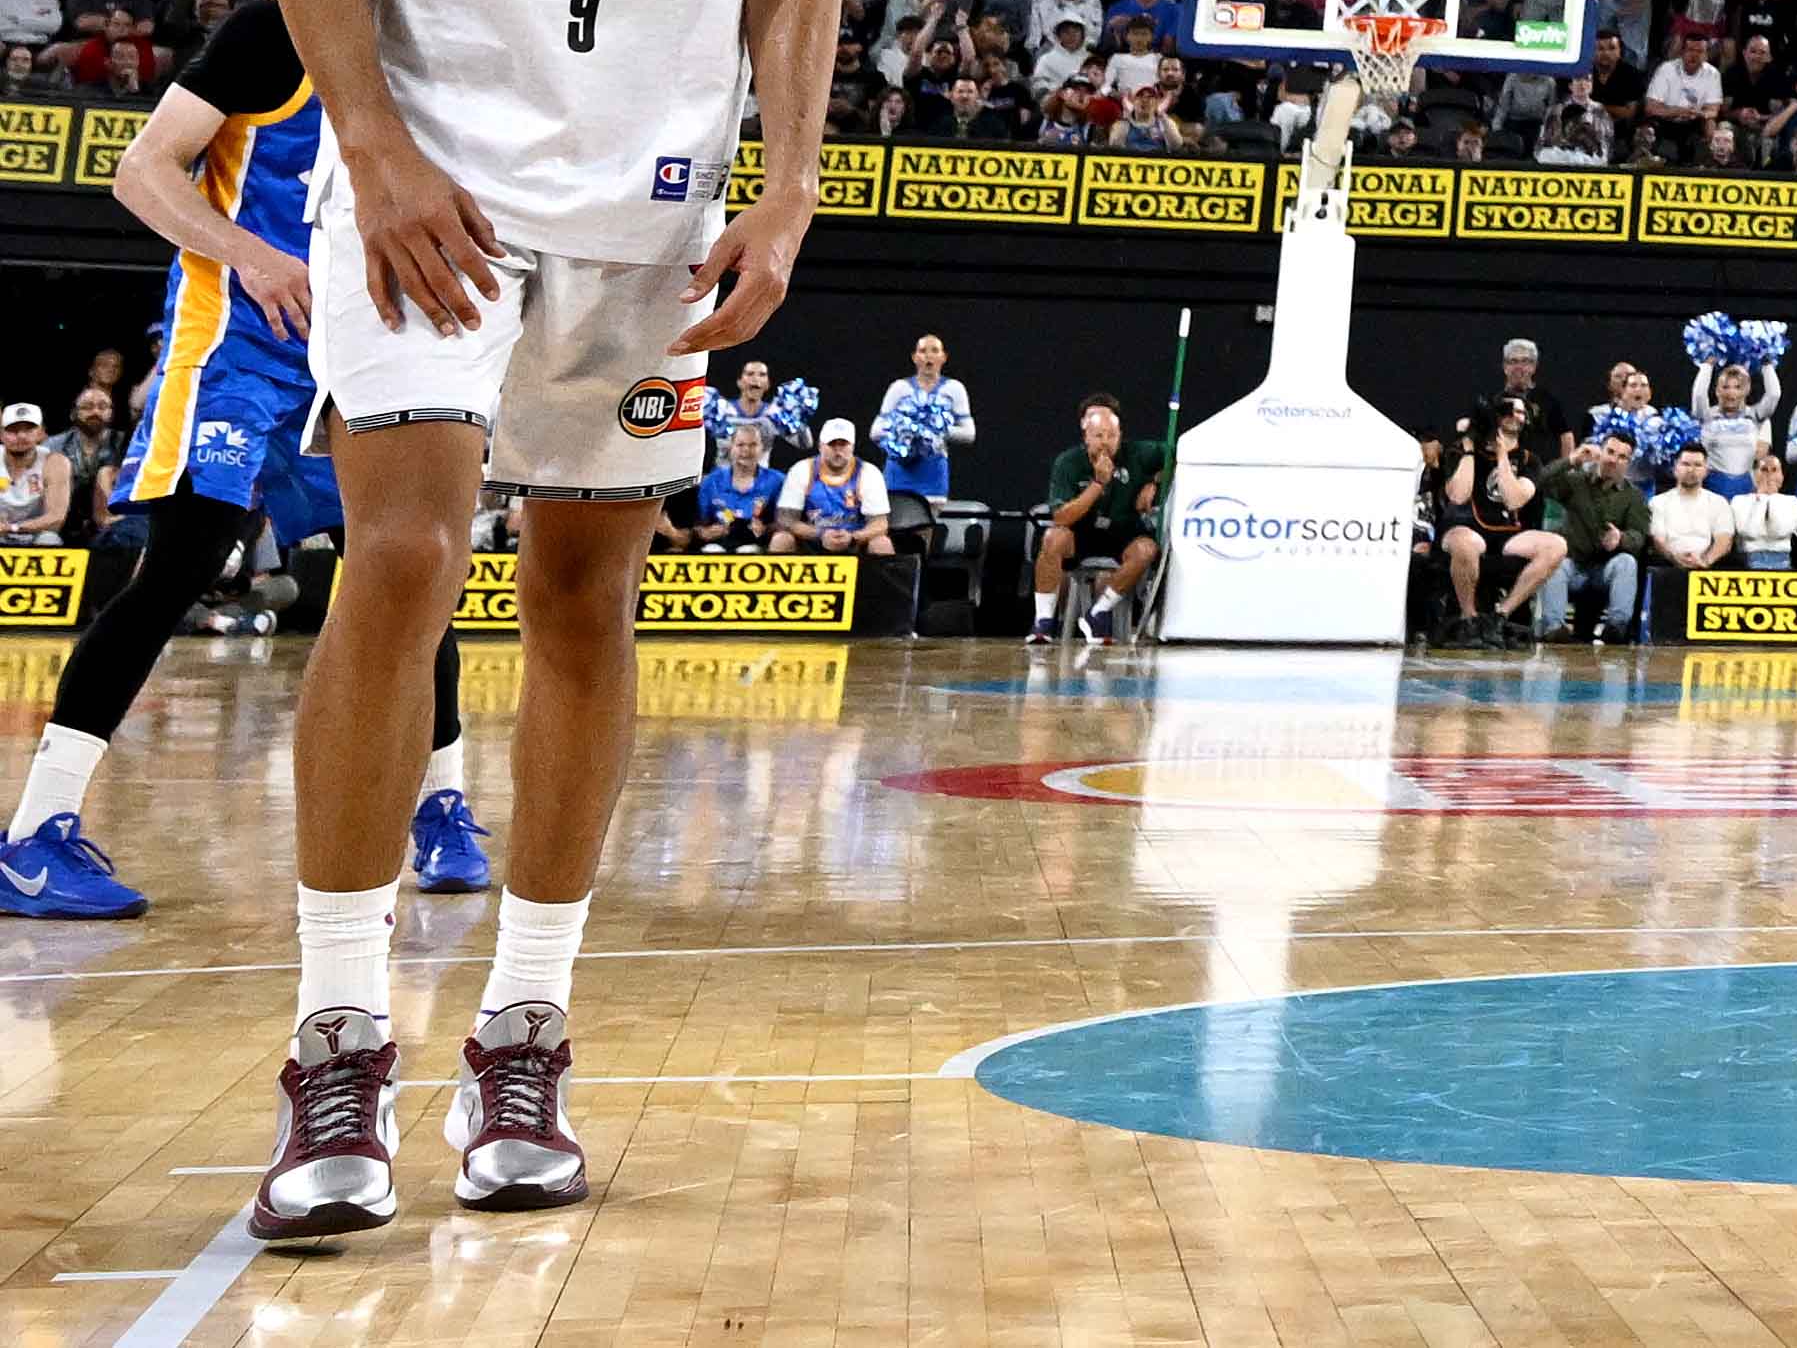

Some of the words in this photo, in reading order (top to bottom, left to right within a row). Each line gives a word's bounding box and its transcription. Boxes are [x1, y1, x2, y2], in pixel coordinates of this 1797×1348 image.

[902, 151, 1069, 183] NATIONAL
[1093, 162, 1255, 190] NATIONAL
[903, 186, 1055, 214] STORAGE
[1468, 174, 1624, 202] NATIONAL
[1094, 192, 1247, 222] STORAGE
[1470, 206, 1616, 232] STORAGE
[1651, 211, 1794, 238] STORAGE
[631, 396, 665, 419] NBL
[196, 448, 248, 467] UniSC
[1183, 513, 1400, 542] motorscout
[643, 560, 847, 585] NATIONAL
[643, 591, 836, 620] STORAGE
